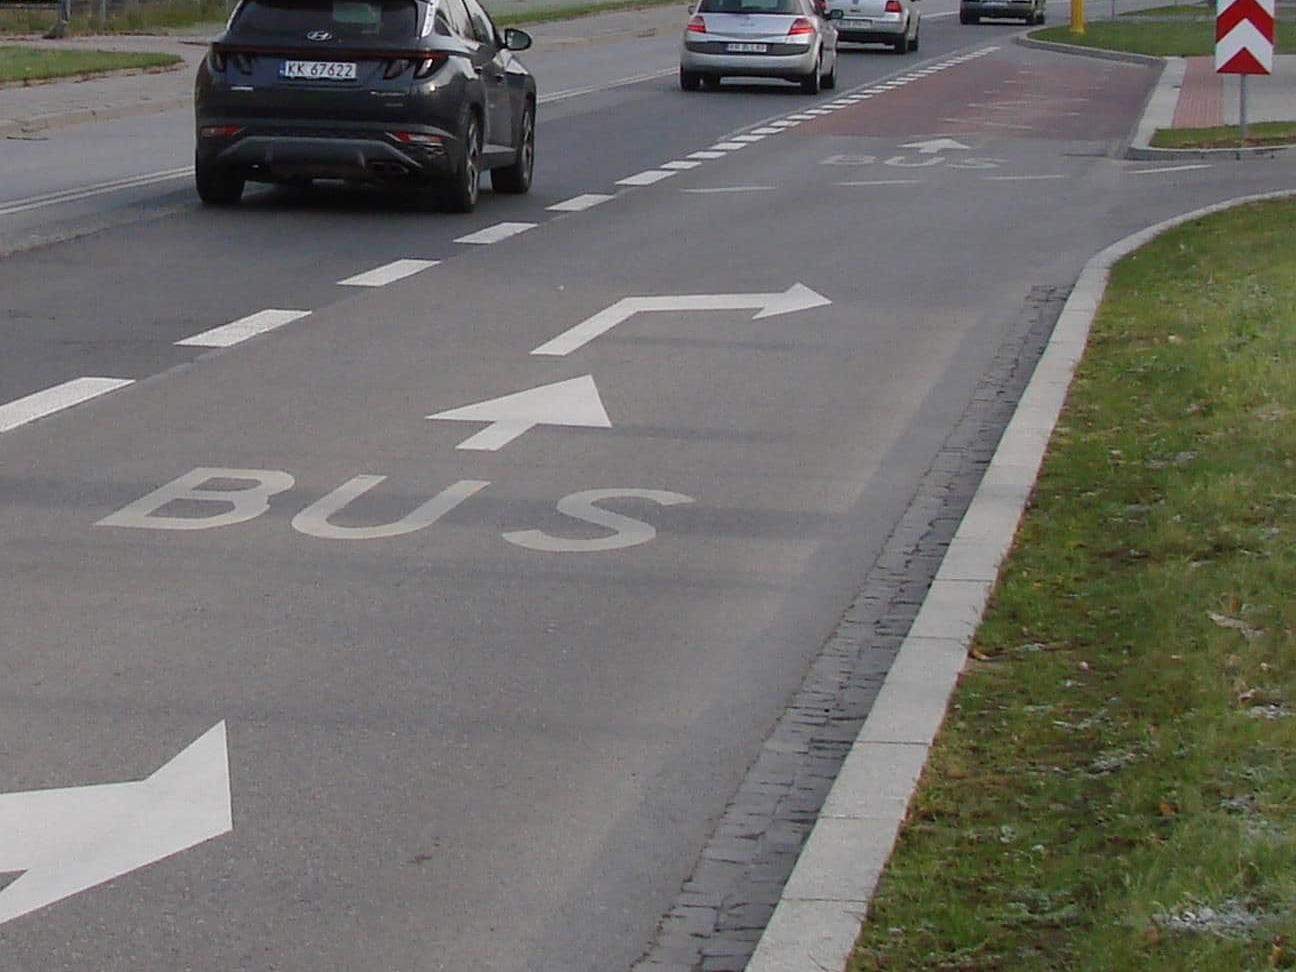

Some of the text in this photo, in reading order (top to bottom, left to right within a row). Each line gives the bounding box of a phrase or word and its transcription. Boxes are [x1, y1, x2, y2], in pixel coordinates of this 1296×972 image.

[287, 61, 354, 77] KK 67622
[93, 466, 697, 553] BUS
